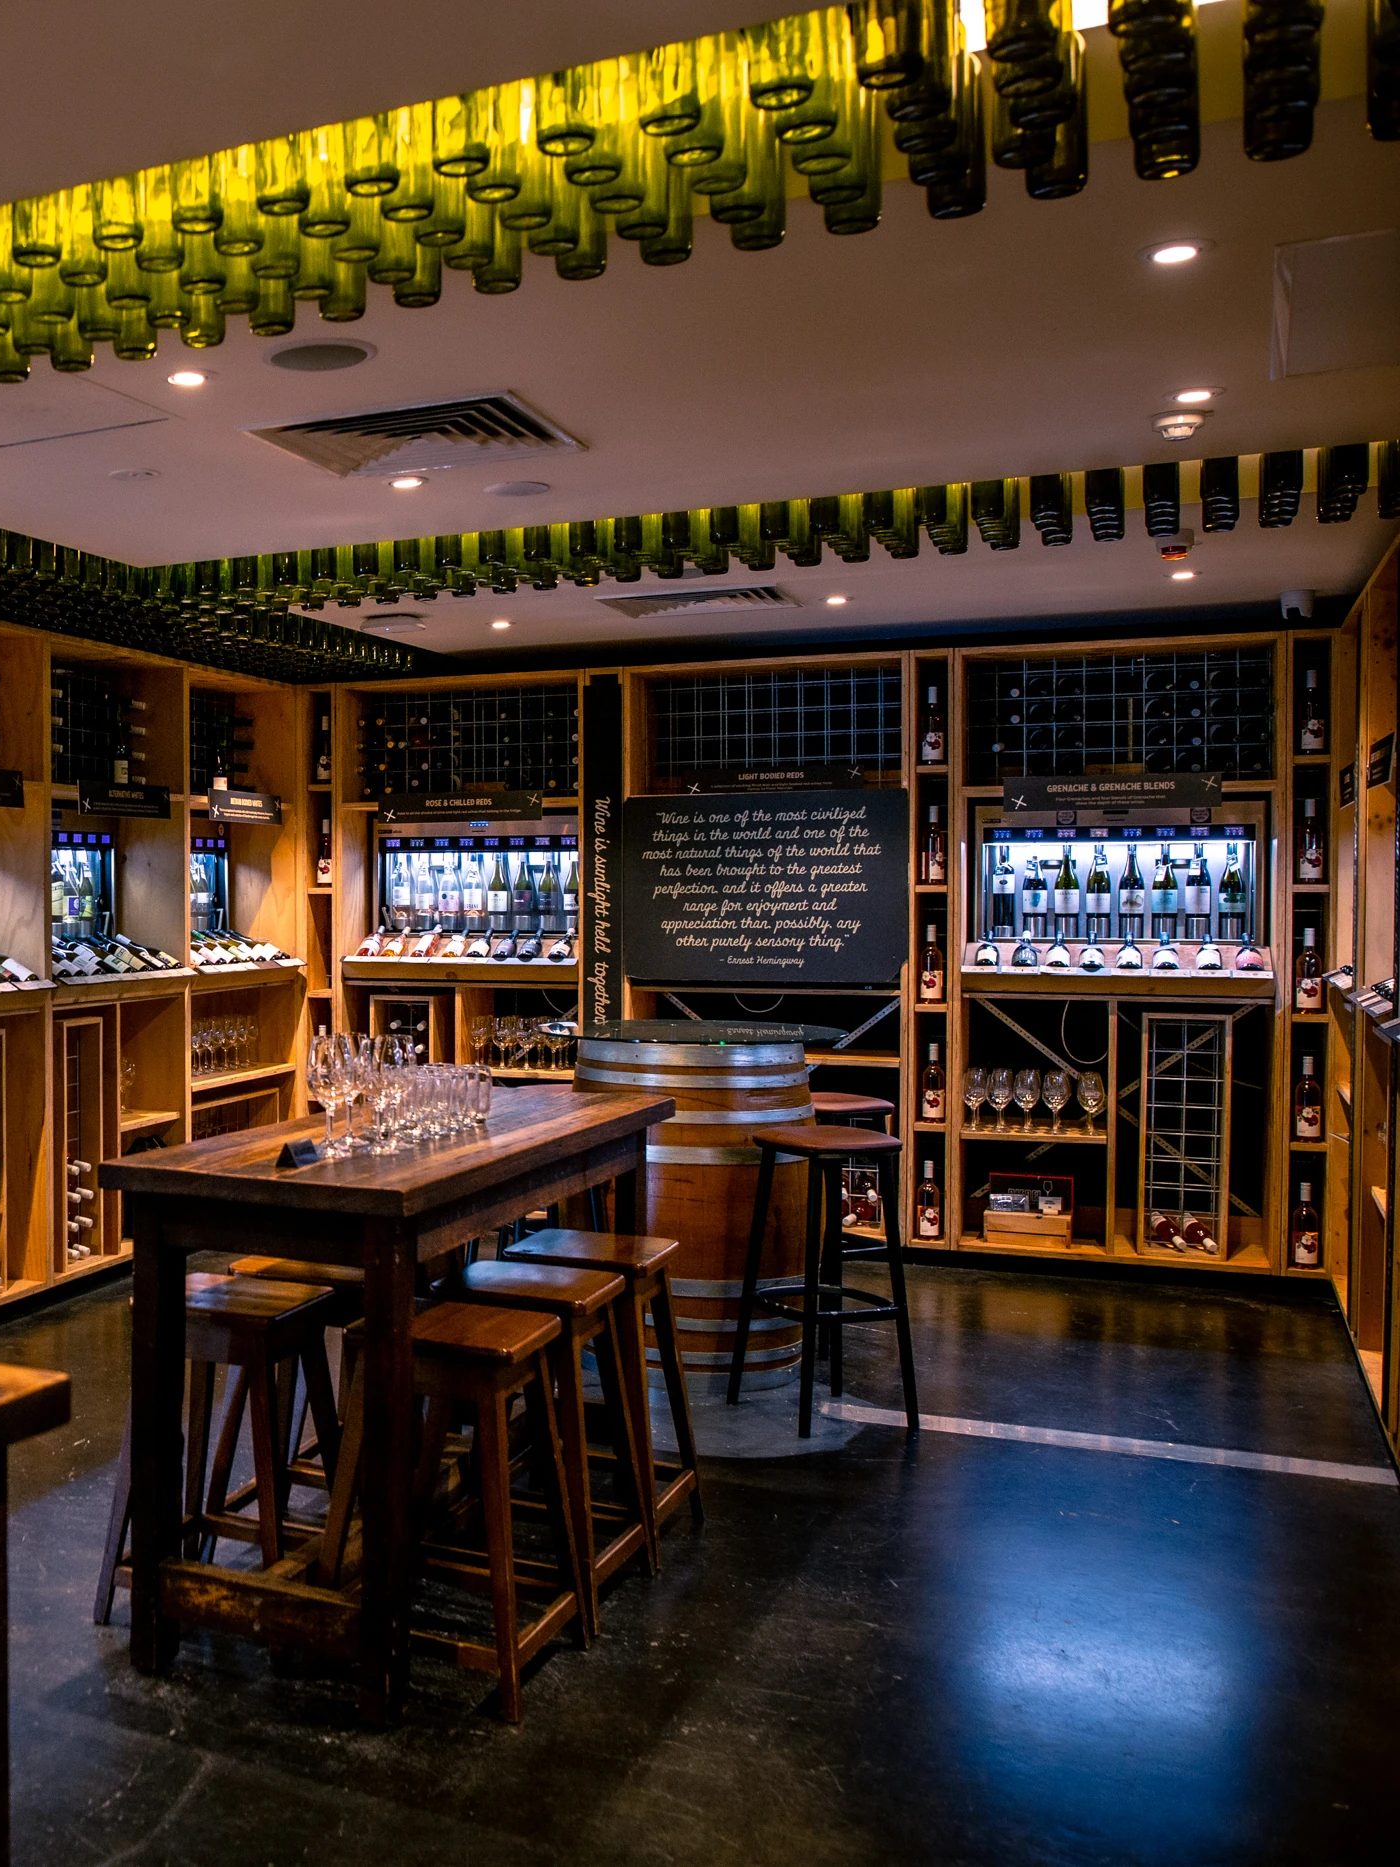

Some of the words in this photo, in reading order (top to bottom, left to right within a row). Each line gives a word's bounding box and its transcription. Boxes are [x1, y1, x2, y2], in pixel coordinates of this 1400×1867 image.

[738, 772, 758, 780] LIGHT
[759, 771, 786, 780] BODIED
[786, 771, 805, 779] REDS
[1046, 783, 1089, 793] GRENACHE
[1090, 783, 1097, 792] &
[1098, 782, 1142, 791] GRENACHE
[1143, 781, 1176, 790] BLENDS
[443, 799, 448, 807] &
[449, 798, 475, 807] CHILLED
[476, 798, 492, 806] REDS
[594, 796, 611, 835] Wine
[693, 811, 705, 823] is
[708, 814, 731, 823] one
[734, 810, 749, 827] of
[752, 809, 772, 821] the
[775, 809, 807, 821] most
[810, 806, 866, 825] civilized
[652, 829, 690, 847] things
[693, 829, 706, 841] in
[709, 828, 729, 840] the
[732, 827, 772, 840] world
[775, 826, 801, 839] and
[803, 829, 826, 838] one
[830, 825, 845, 843] of
[849, 825, 869, 837] the
[595, 838, 611, 853] is
[642, 848, 673, 860] most
[675, 846, 722, 859] natural
[725, 846, 763, 863] things
[767, 845, 782, 862] of
[786, 844, 806, 856] the
[809, 843, 850, 856] world
[853, 843, 881, 855] that
[660, 864, 682, 876] has
[685, 864, 712, 876] been
[716, 863, 767, 881] brought
[769, 864, 784, 875] to
[787, 862, 807, 875] the
[810, 862, 863, 880] greatest
[587, 854, 611, 917] sunlight
[722, 881, 747, 893] and
[750, 881, 761, 893] it
[764, 880, 804, 898] offers
[808, 884, 817, 892] a
[820, 880, 868, 898] greater
[683, 902, 718, 917] range
[720, 899, 743, 917] for
[746, 899, 809, 916] enjoyment
[812, 898, 837, 911] and
[661, 917, 737, 934] appreciation
[836, 919, 861, 934] any
[594, 920, 611, 953] held
[675, 934, 709, 947] other
[710, 934, 752, 952] purely
[755, 937, 806, 952] sensory
[727, 955, 754, 965] Ernest
[756, 955, 805, 968] Hemingway
